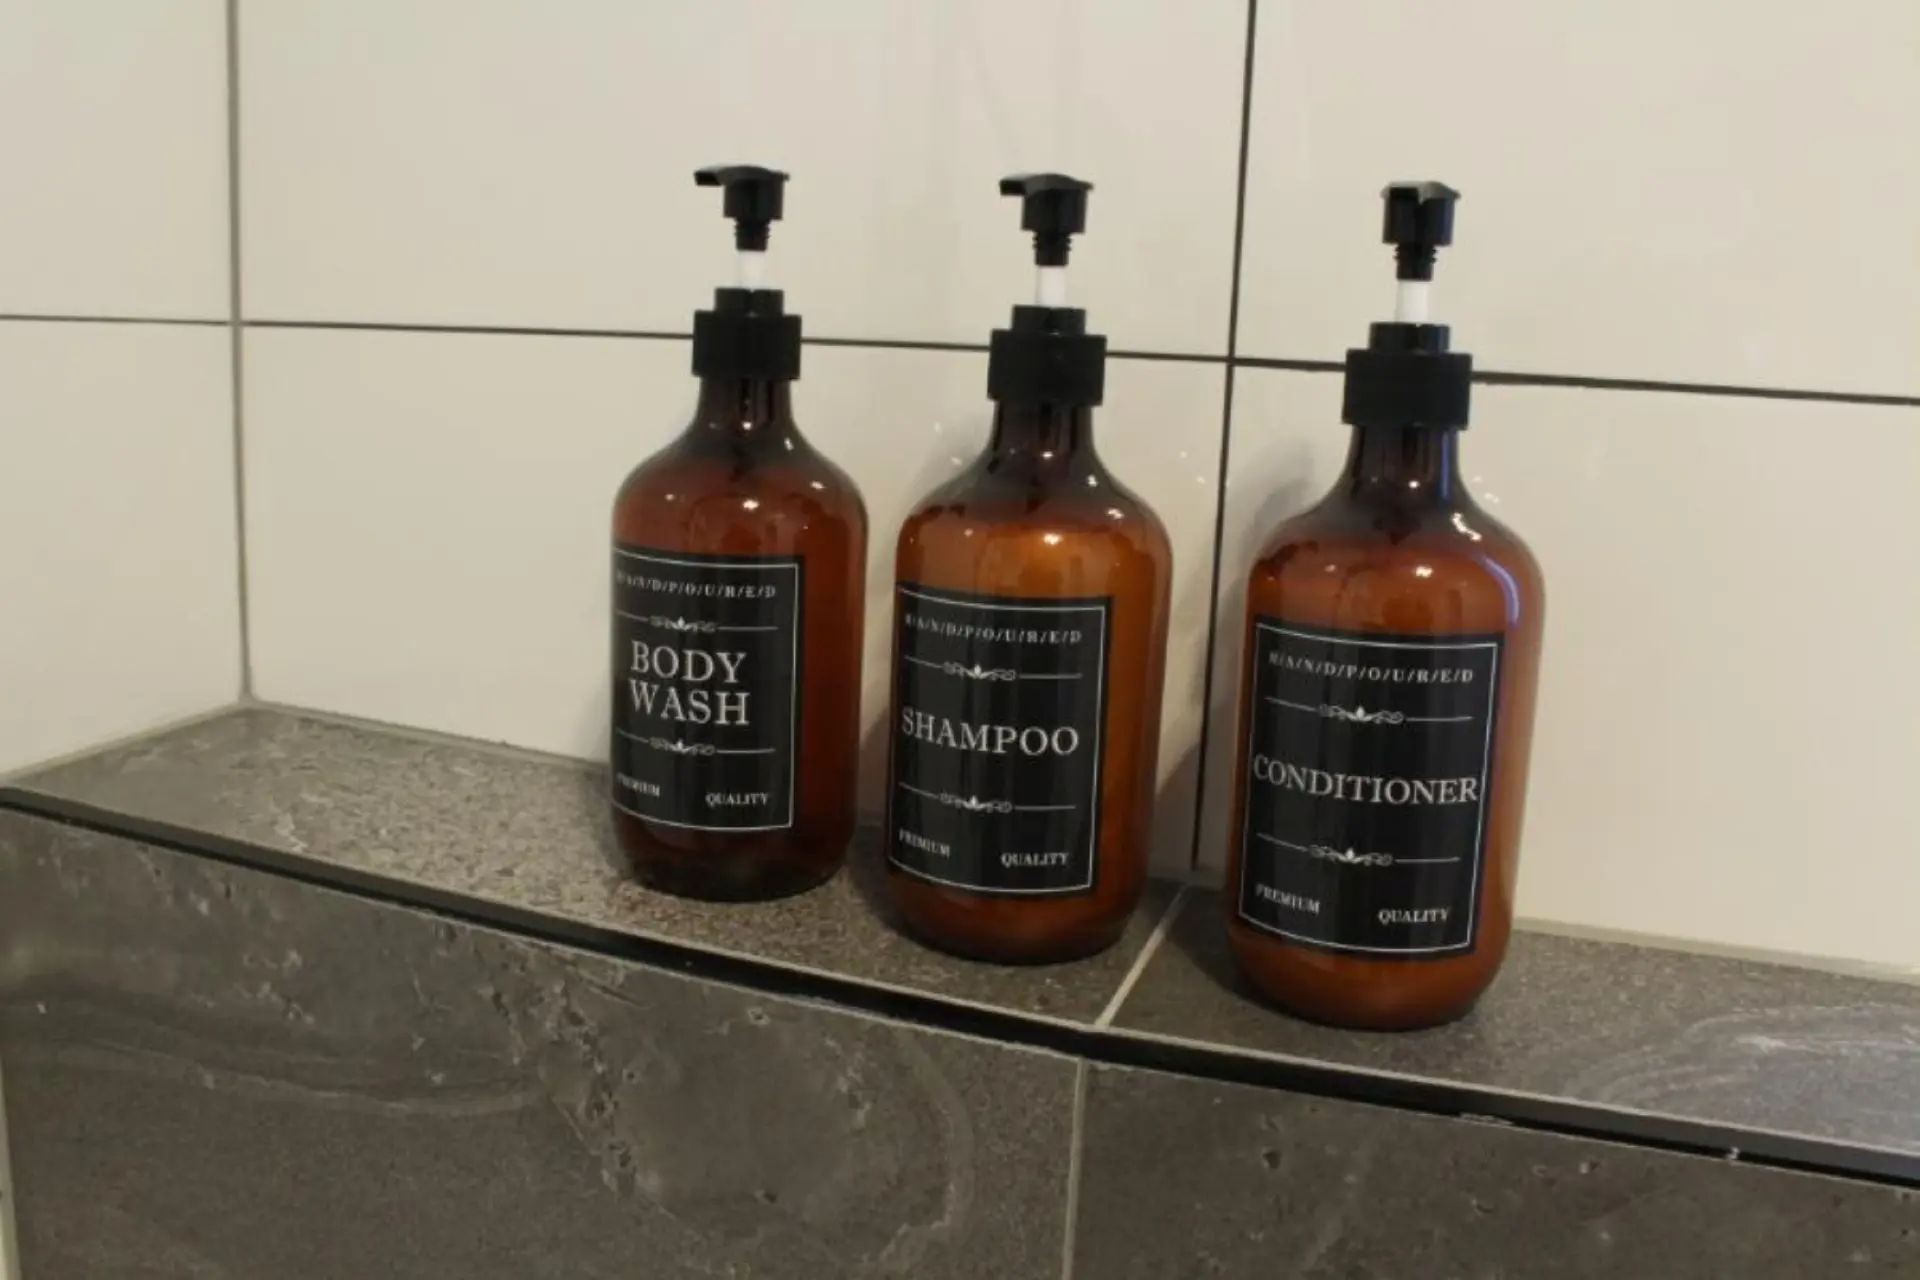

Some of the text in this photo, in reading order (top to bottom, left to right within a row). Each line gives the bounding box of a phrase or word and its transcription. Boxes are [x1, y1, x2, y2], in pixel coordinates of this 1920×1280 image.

[630, 640, 747, 683] BODY
[628, 679, 750, 725] WASH
[901, 707, 1080, 756] SHAMPOO
[705, 792, 769, 809] QUALITY
[1253, 753, 1480, 805] CONDITIONER
[899, 827, 1069, 868] PREMIUM QUALITY
[1255, 883, 1449, 926] PREMIUM QUALITY
